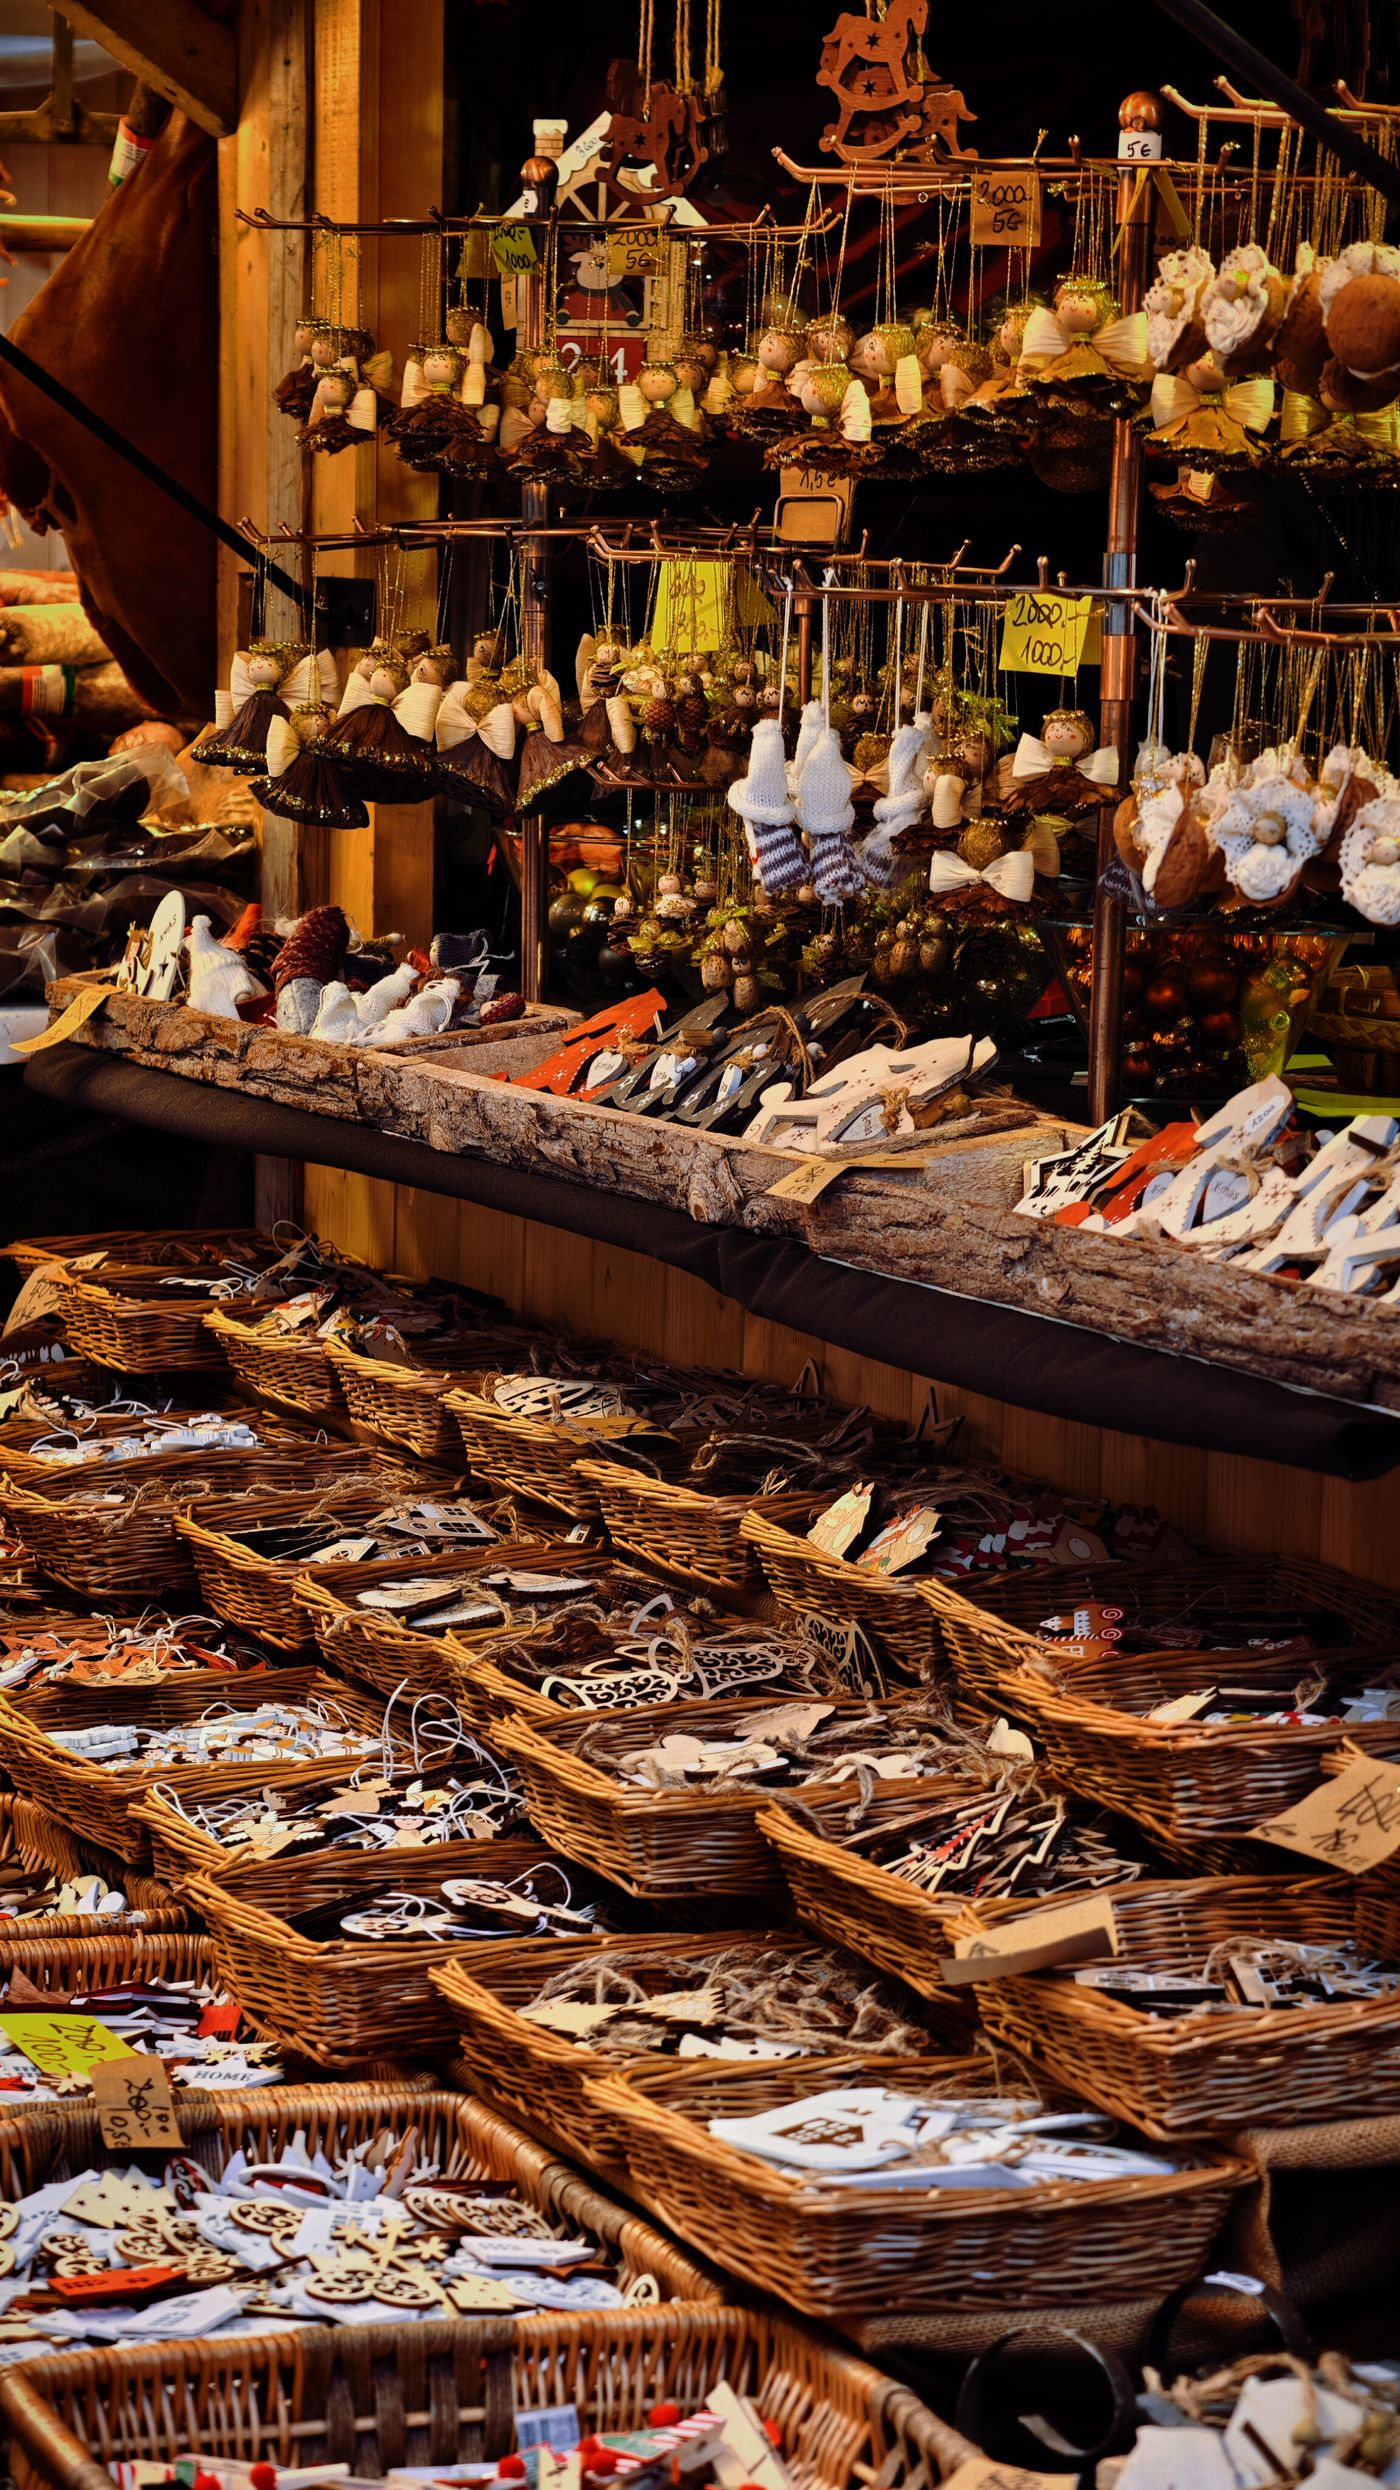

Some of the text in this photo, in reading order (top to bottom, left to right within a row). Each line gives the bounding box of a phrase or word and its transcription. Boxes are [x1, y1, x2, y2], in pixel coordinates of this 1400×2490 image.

[1127, 140, 1152, 157] 5€
[992, 208, 1023, 233] 5€
[1213, 1178, 1242, 1201] X-mas
[193, 2069, 254, 2083] HOME
